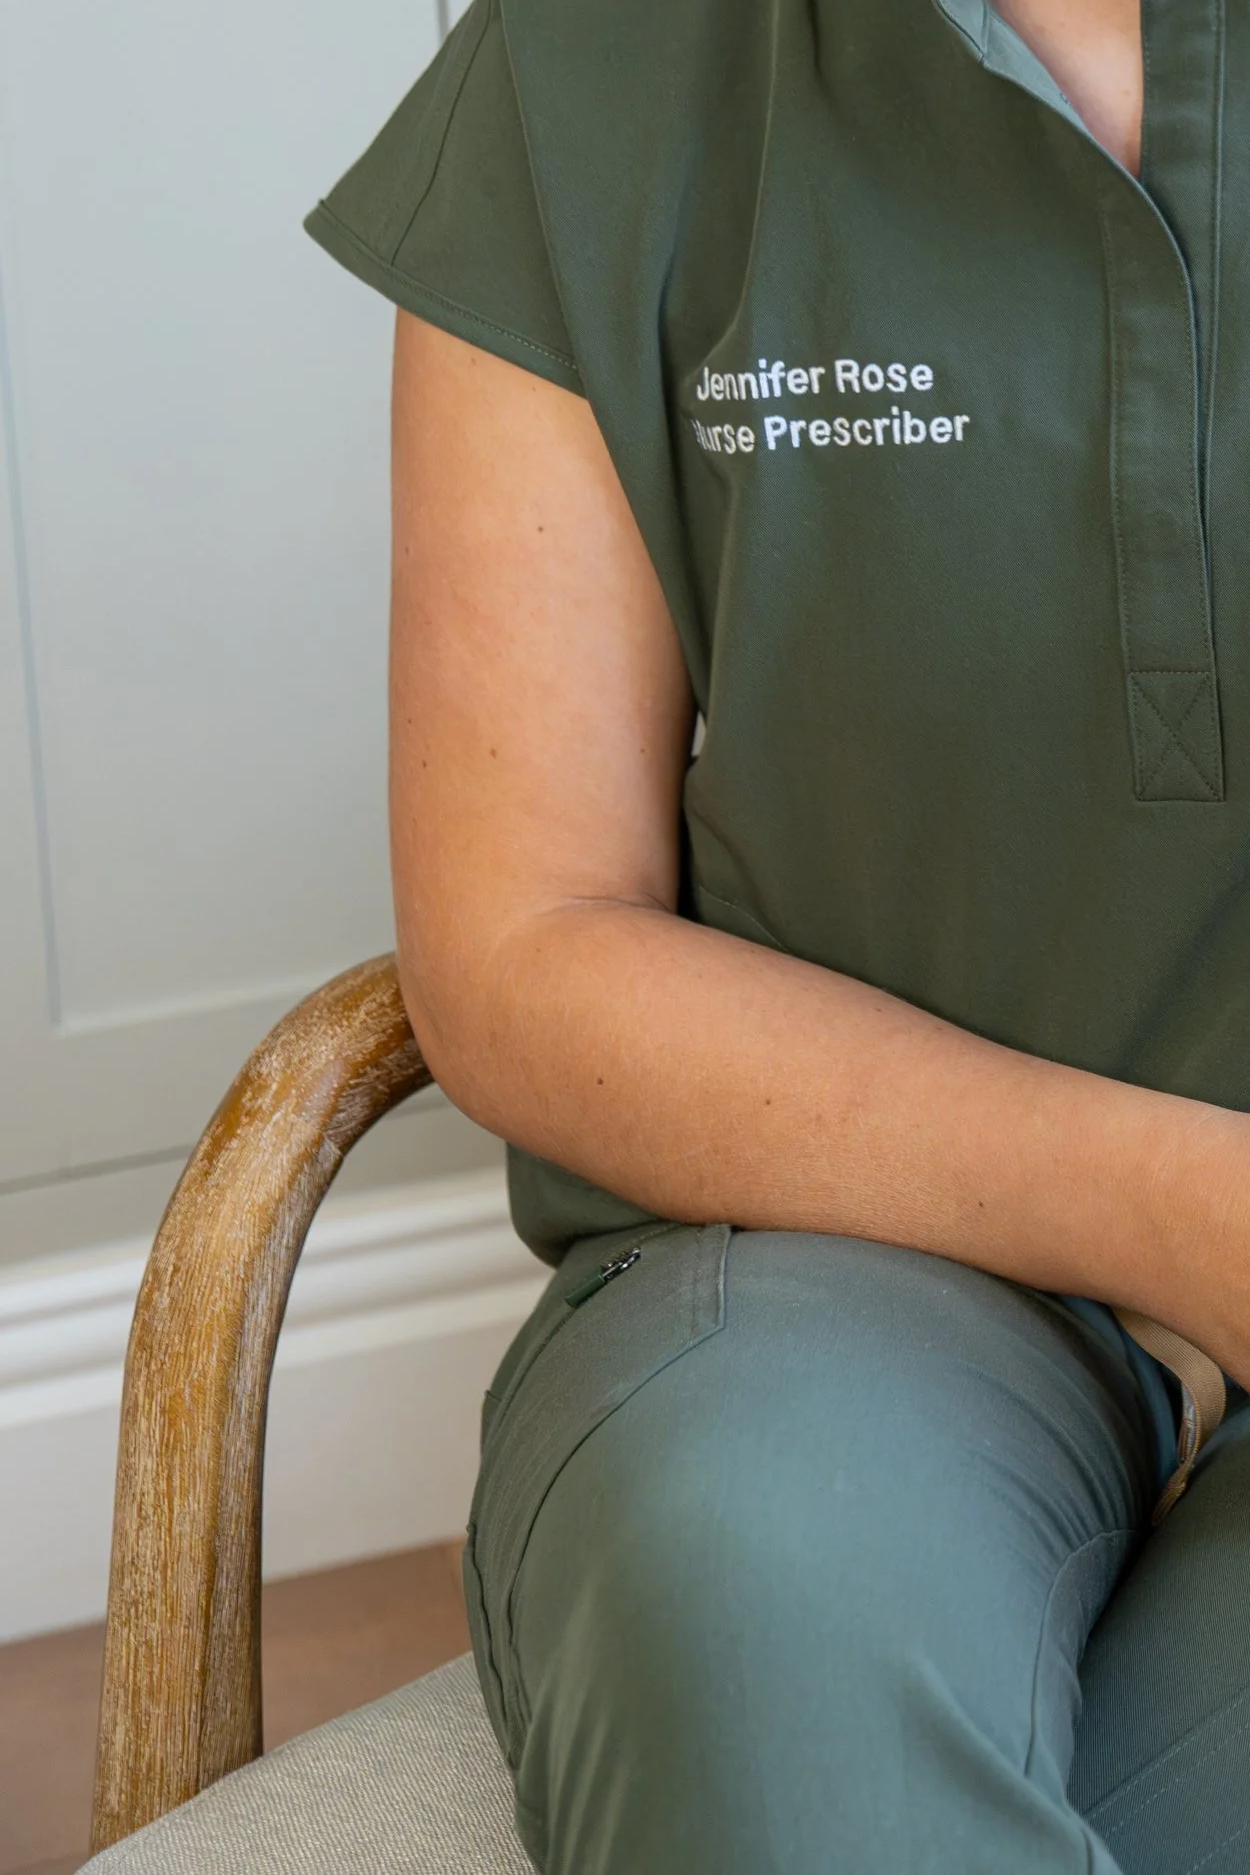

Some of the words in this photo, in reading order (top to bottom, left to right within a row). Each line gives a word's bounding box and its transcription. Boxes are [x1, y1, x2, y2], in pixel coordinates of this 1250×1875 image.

[697, 358, 825, 401] Jennifer
[834, 358, 934, 393] Rose
[763, 406, 970, 450] Prescriber
